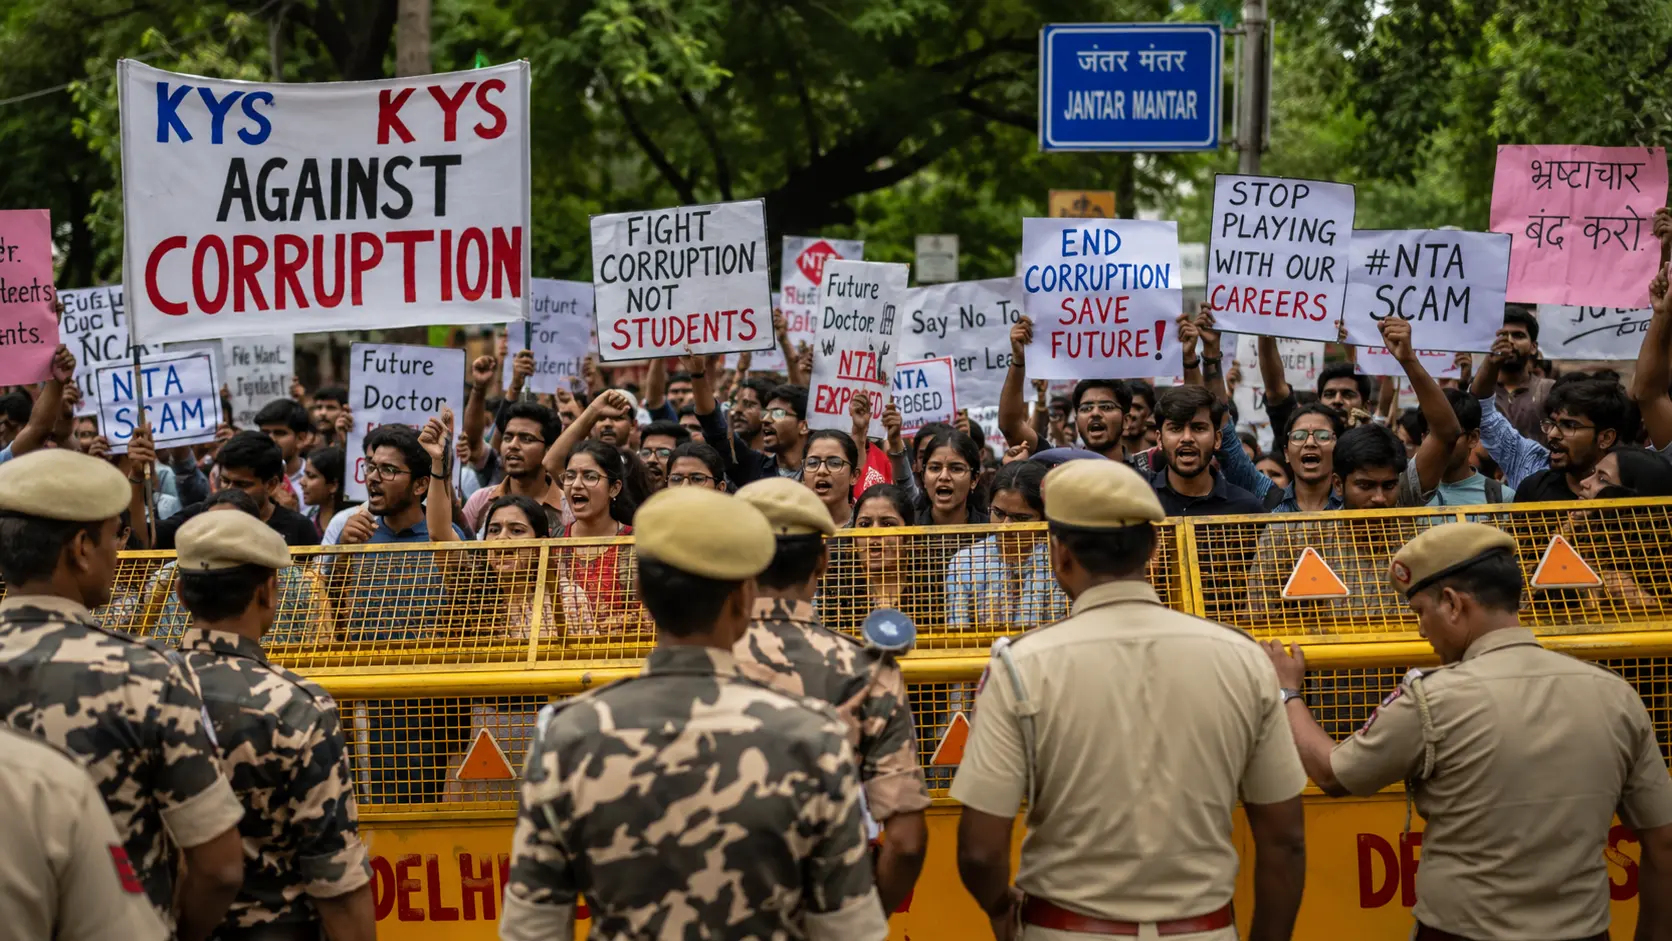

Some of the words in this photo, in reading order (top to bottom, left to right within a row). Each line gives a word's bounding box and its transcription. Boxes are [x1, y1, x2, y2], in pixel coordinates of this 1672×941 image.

[1077, 44, 1130, 72] जंतर
[1138, 43, 1188, 72] मंतर
[156, 81, 275, 146] KYS
[377, 79, 507, 145] KYS
[1063, 90, 1126, 120] JANTAR
[1132, 90, 1198, 120] MANTAR
[216, 154, 462, 222] AGAINST
[1531, 160, 1646, 193] भ्रष्टाचार
[1229, 181, 1310, 209] STOP
[627, 211, 712, 246] FIGHT
[1061, 228, 1122, 257] END
[1222, 212, 1336, 246] PLAYING
[1525, 208, 1570, 250] बंद
[144, 226, 522, 317] CORRUPTION
[600, 241, 756, 284] CORRUPTION
[1024, 263, 1171, 293] CORRUPTION
[1215, 249, 1274, 278] WITH
[1286, 253, 1335, 284] OUR
[1364, 243, 1465, 279] #NTA
[626, 284, 679, 314] NOT
[827, 273, 879, 300] Future
[1210, 284, 1328, 322] CAREERS
[1369, 284, 1471, 324] SCAM
[912, 310, 948, 339] Say
[959, 304, 986, 329] No
[996, 300, 1020, 325] To
[1058, 295, 1130, 326] SAVE
[611, 308, 758, 351] STUDENTS
[1051, 320, 1167, 361] FUTURE!
[362, 351, 435, 376] Future
[985, 346, 1013, 370] Lea
[112, 364, 184, 402] NTA
[363, 386, 447, 412] Doctor
[814, 384, 883, 420] EXPED
